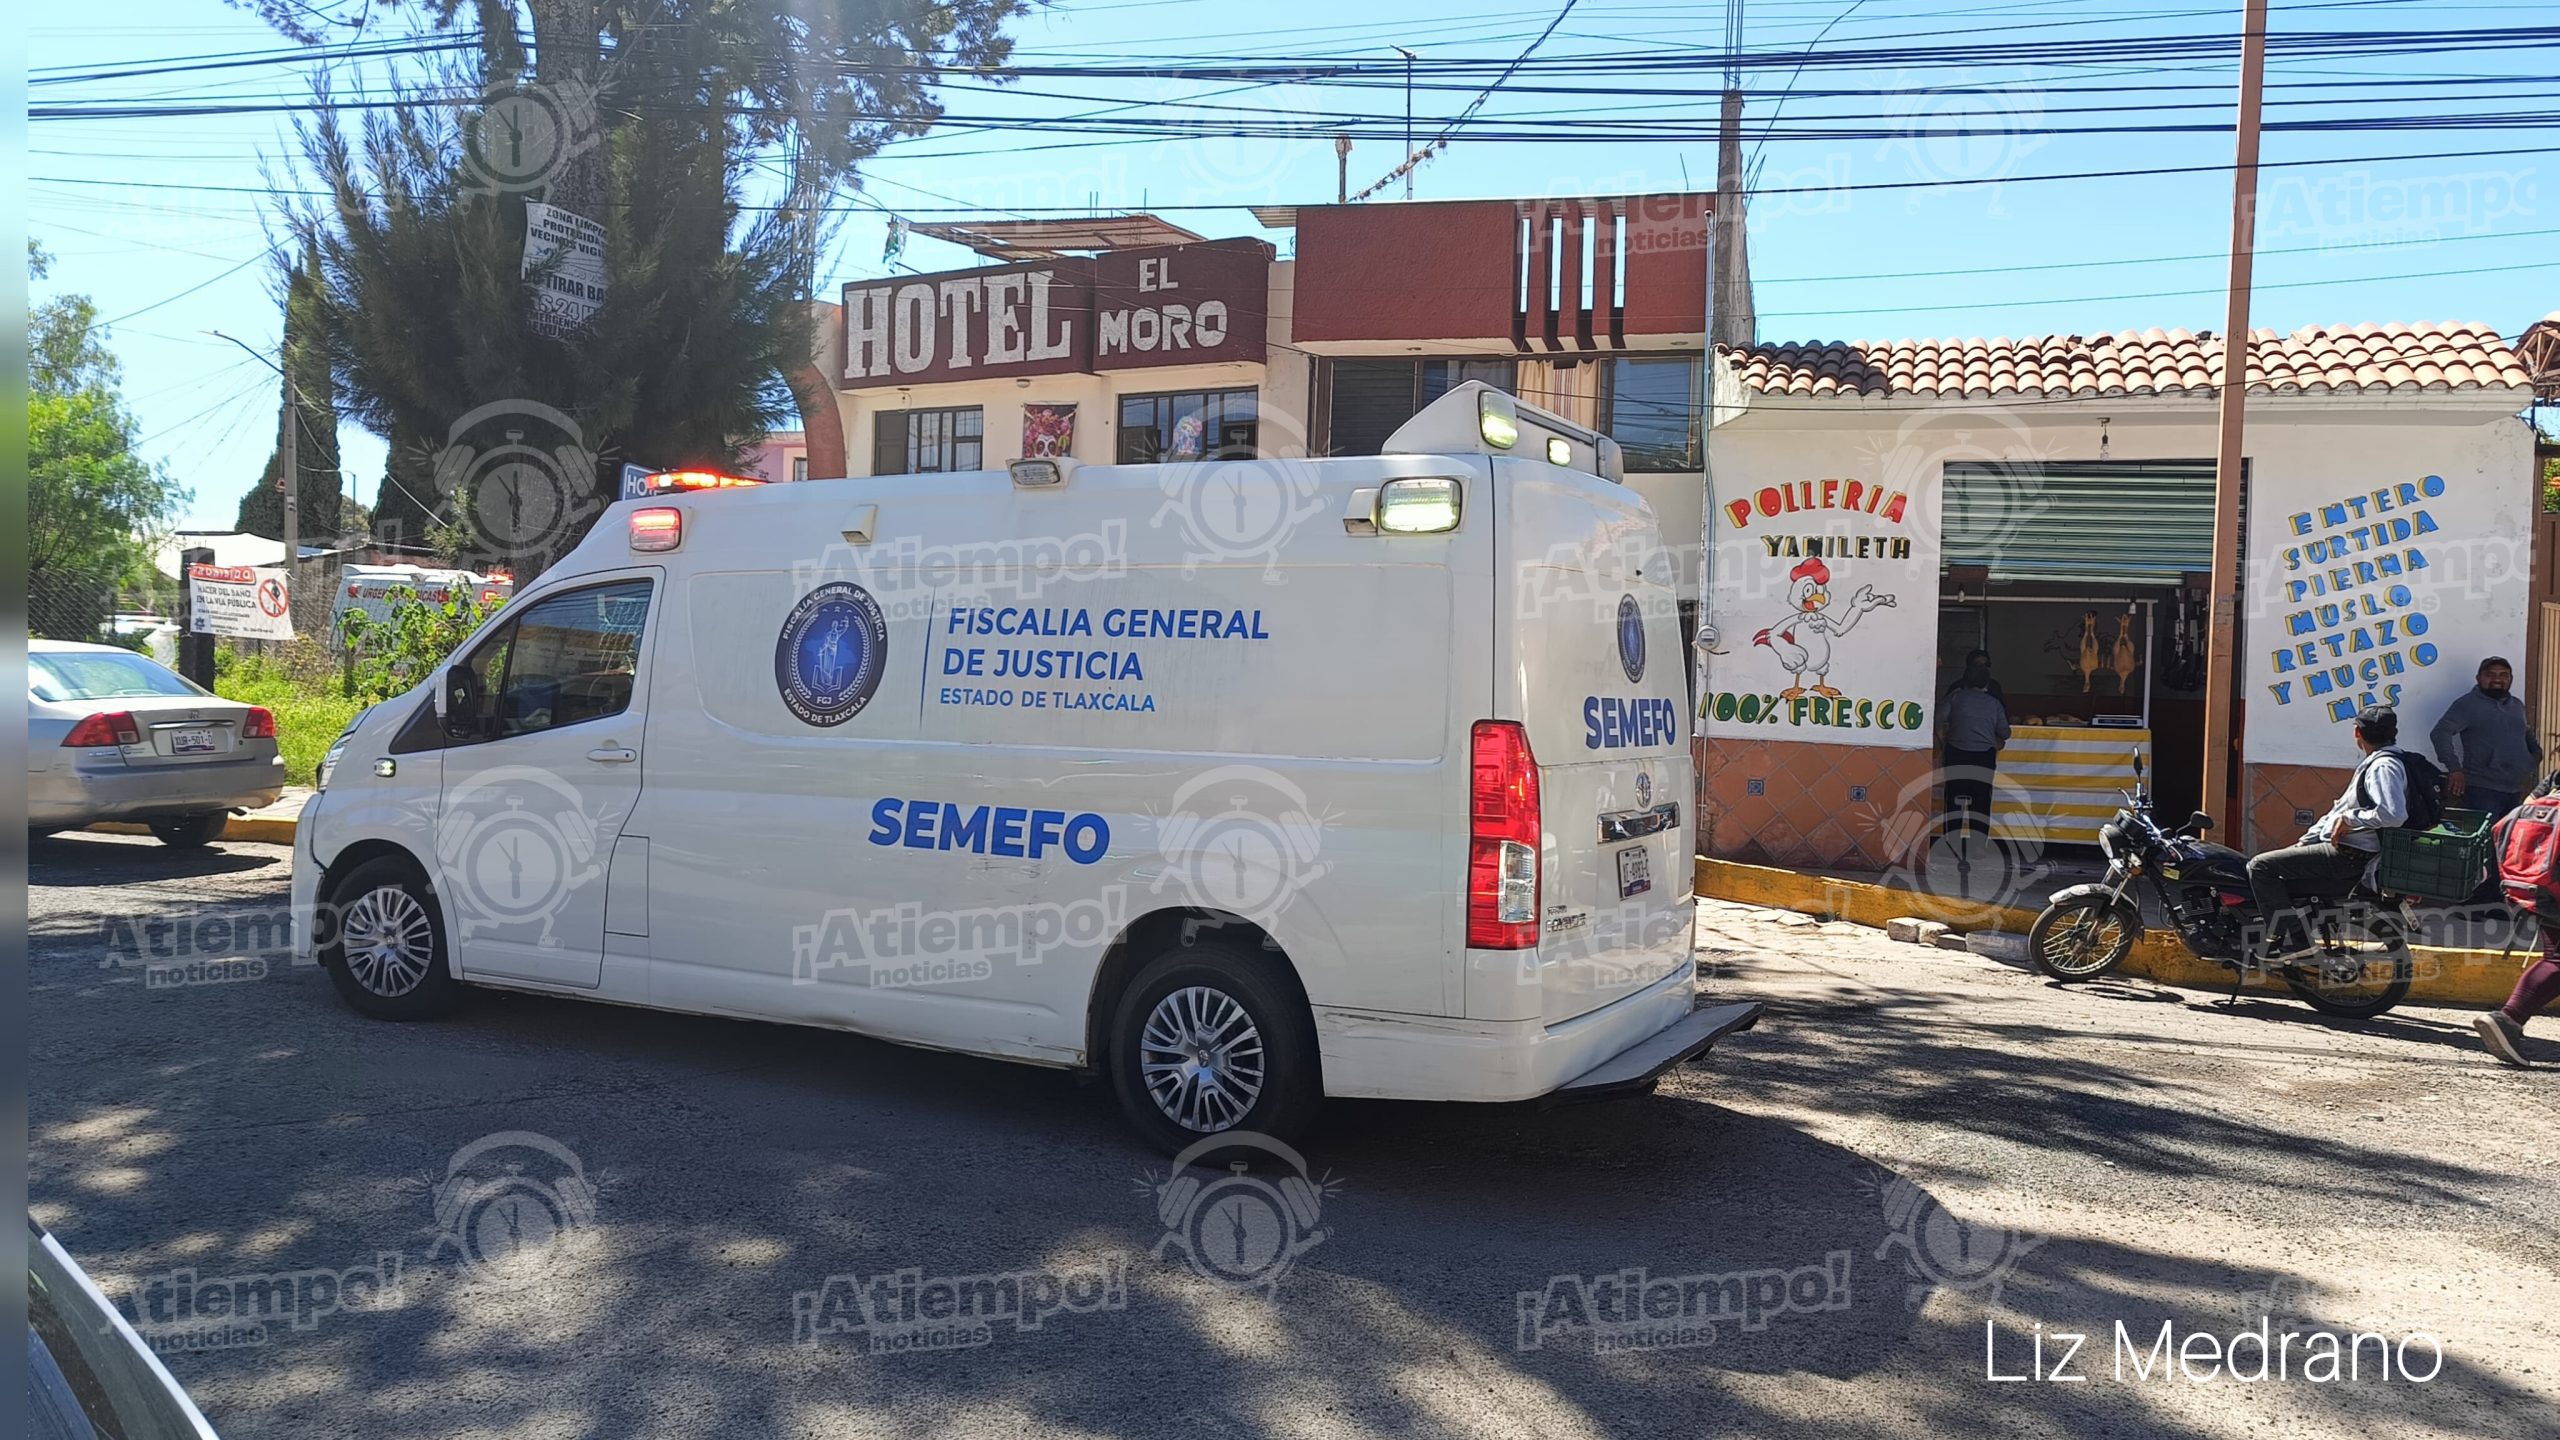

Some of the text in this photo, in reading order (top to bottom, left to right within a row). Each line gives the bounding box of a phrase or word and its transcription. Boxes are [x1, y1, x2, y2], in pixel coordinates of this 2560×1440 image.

[546, 207, 573, 223] ZONA
[546, 275, 584, 298] TIRAR
[1138, 257, 1179, 293] EL
[844, 270, 1071, 379] HOTEL
[1099, 300, 1227, 356] MORO
[1724, 478, 1908, 529] POLLERIA
[2288, 474, 2445, 536] ENTERO
[1760, 534, 1911, 560] YAMILETH
[2282, 510, 2439, 571] SURTIDA
[218, 588, 230, 597] DEL
[2285, 547, 2430, 603] PIERNA
[813, 585, 852, 600] GENERAL
[854, 590, 866, 602] DE
[864, 598, 885, 642] JUSTICIA
[947, 607, 1269, 640] FISCALIA GENERAL
[2285, 584, 2412, 636] MUSLO
[942, 648, 1144, 681] DE JUSTICIA
[2271, 612, 2429, 674] RETAZO
[2268, 642, 2438, 705] Y MUCHO
[783, 688, 867, 724] ESTADO DE TLAXCALA
[940, 688, 1156, 713] ESTADO DE TLAXCALA
[1583, 696, 1676, 750] SEMEFO
[1698, 692, 1924, 732] 100% FRESCO
[868, 797, 1111, 865] SEMEFO
